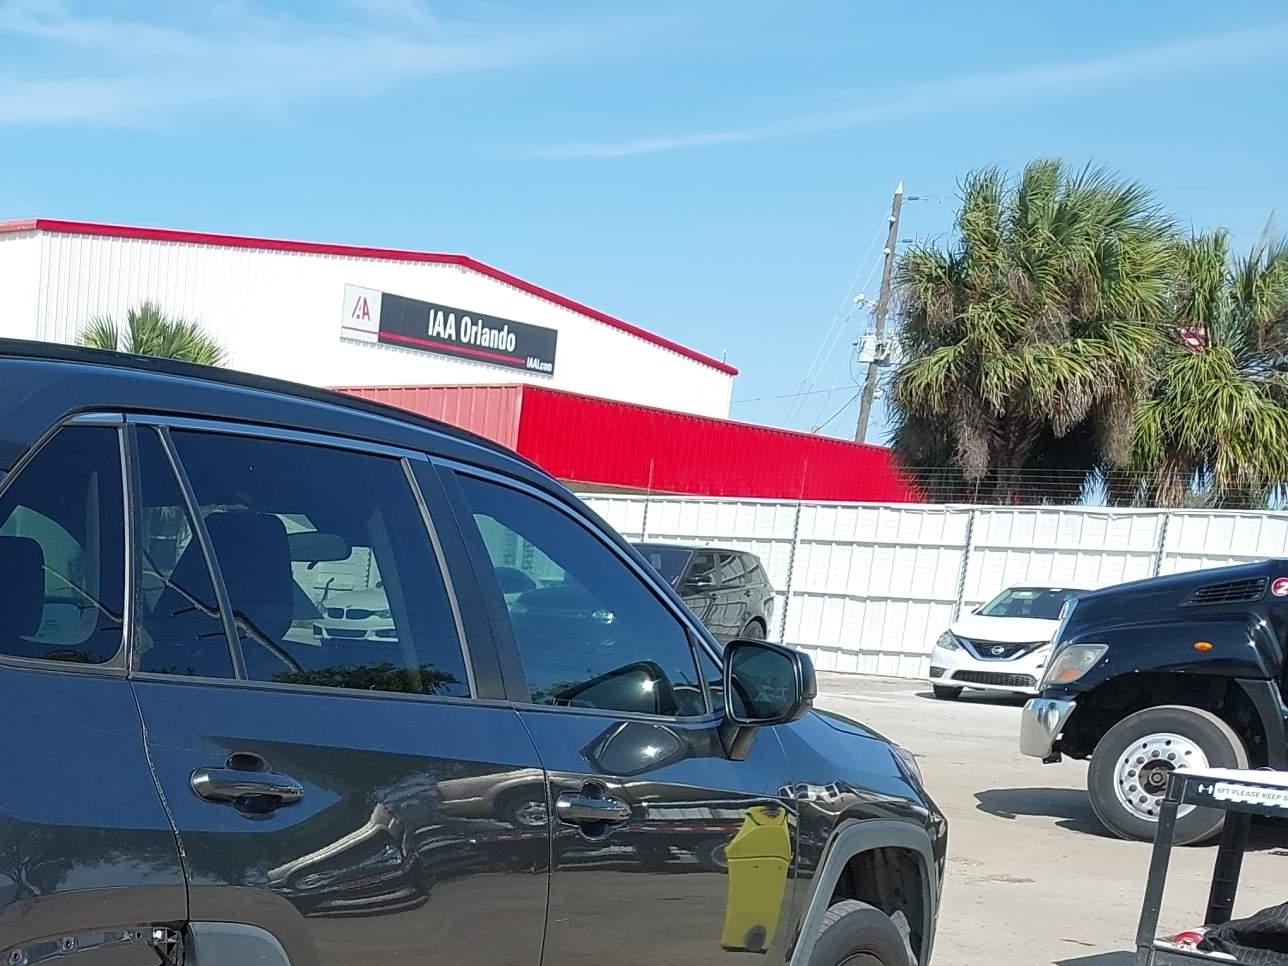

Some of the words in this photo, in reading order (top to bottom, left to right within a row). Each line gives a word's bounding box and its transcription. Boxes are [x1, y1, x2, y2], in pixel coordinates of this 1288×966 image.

[428, 308, 456, 340] IAA
[460, 313, 516, 352] Orlando
[1232, 789, 1260, 798] PLEASE
[1262, 792, 1281, 800] KEEP
